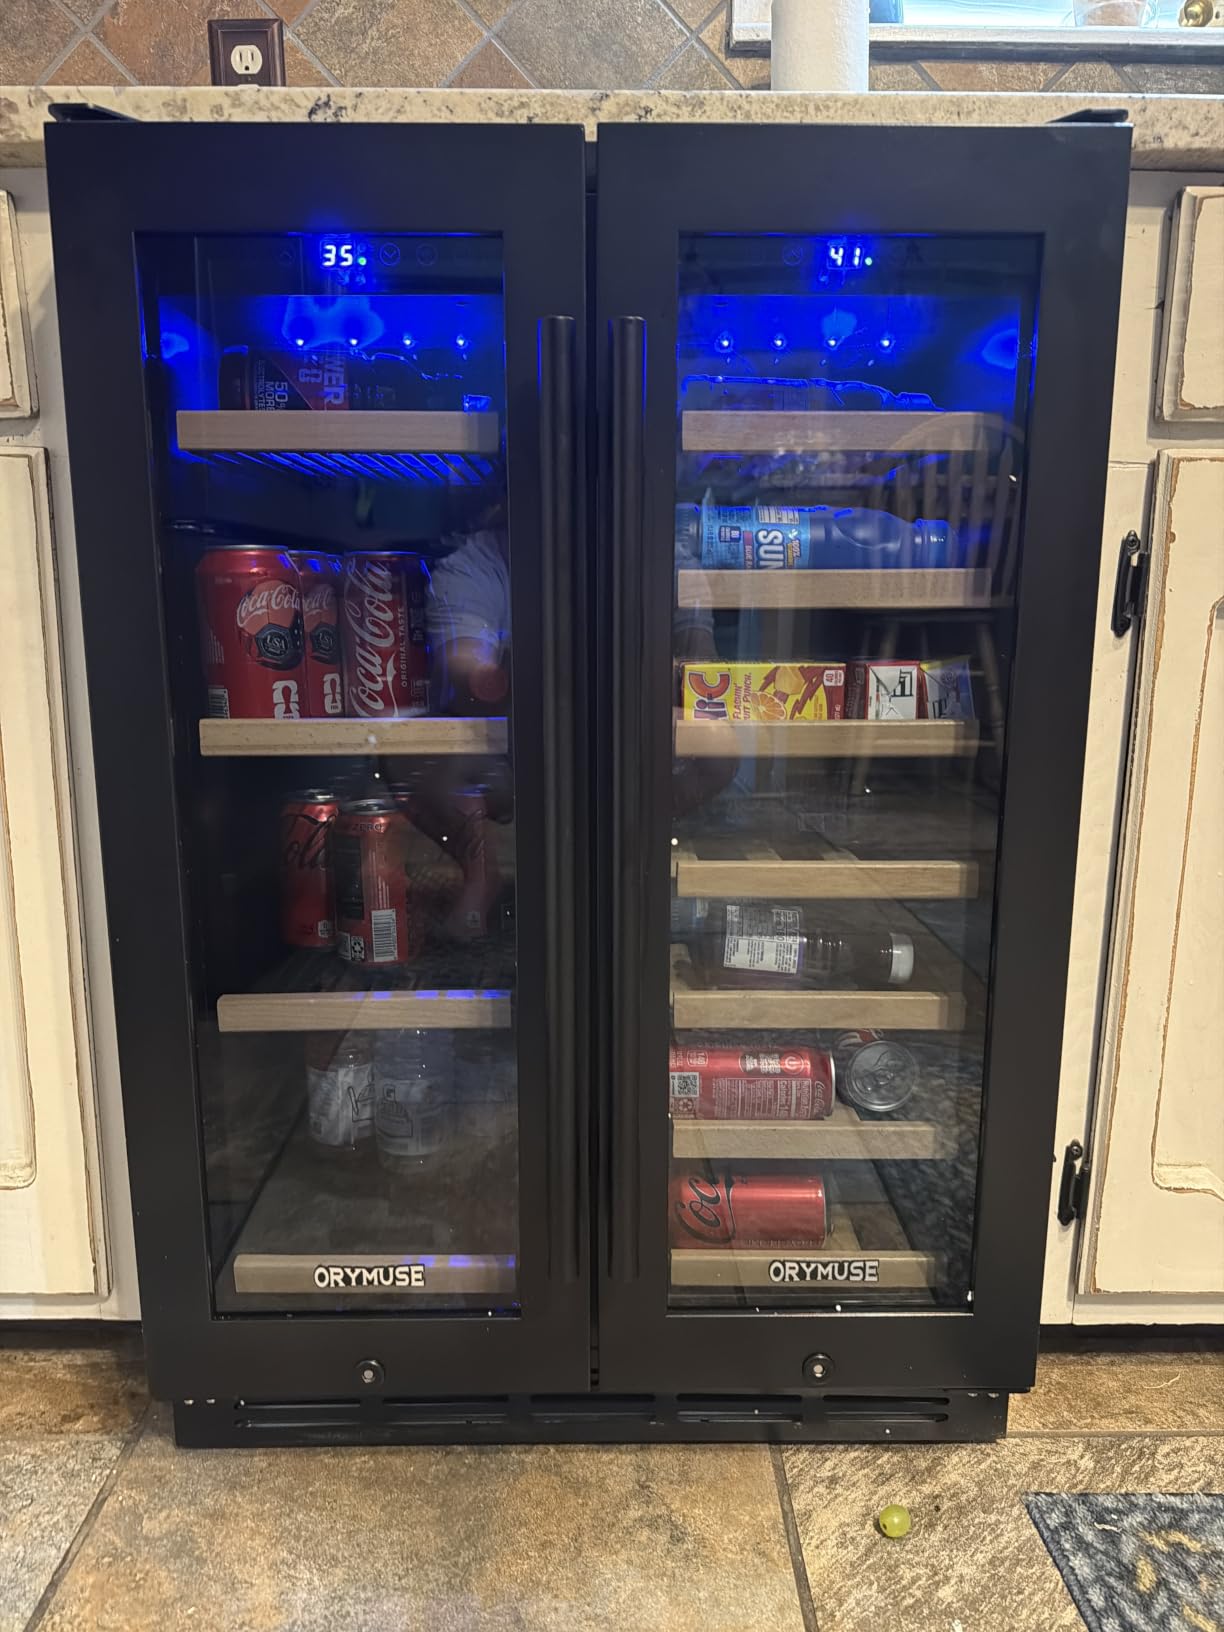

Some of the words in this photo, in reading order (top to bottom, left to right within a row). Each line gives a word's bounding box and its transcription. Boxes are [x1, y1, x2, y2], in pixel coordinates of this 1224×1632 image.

[323, 244, 353, 266] 35
[830, 246, 861, 267] 41
[397, 606, 406, 636] TASTE
[344, 557, 395, 717] Coca-Cola
[399, 639, 408, 688] ORIGINAL
[313, 1265, 426, 1289] ORYMUSE
[769, 1259, 880, 1283] ORYMUSE
